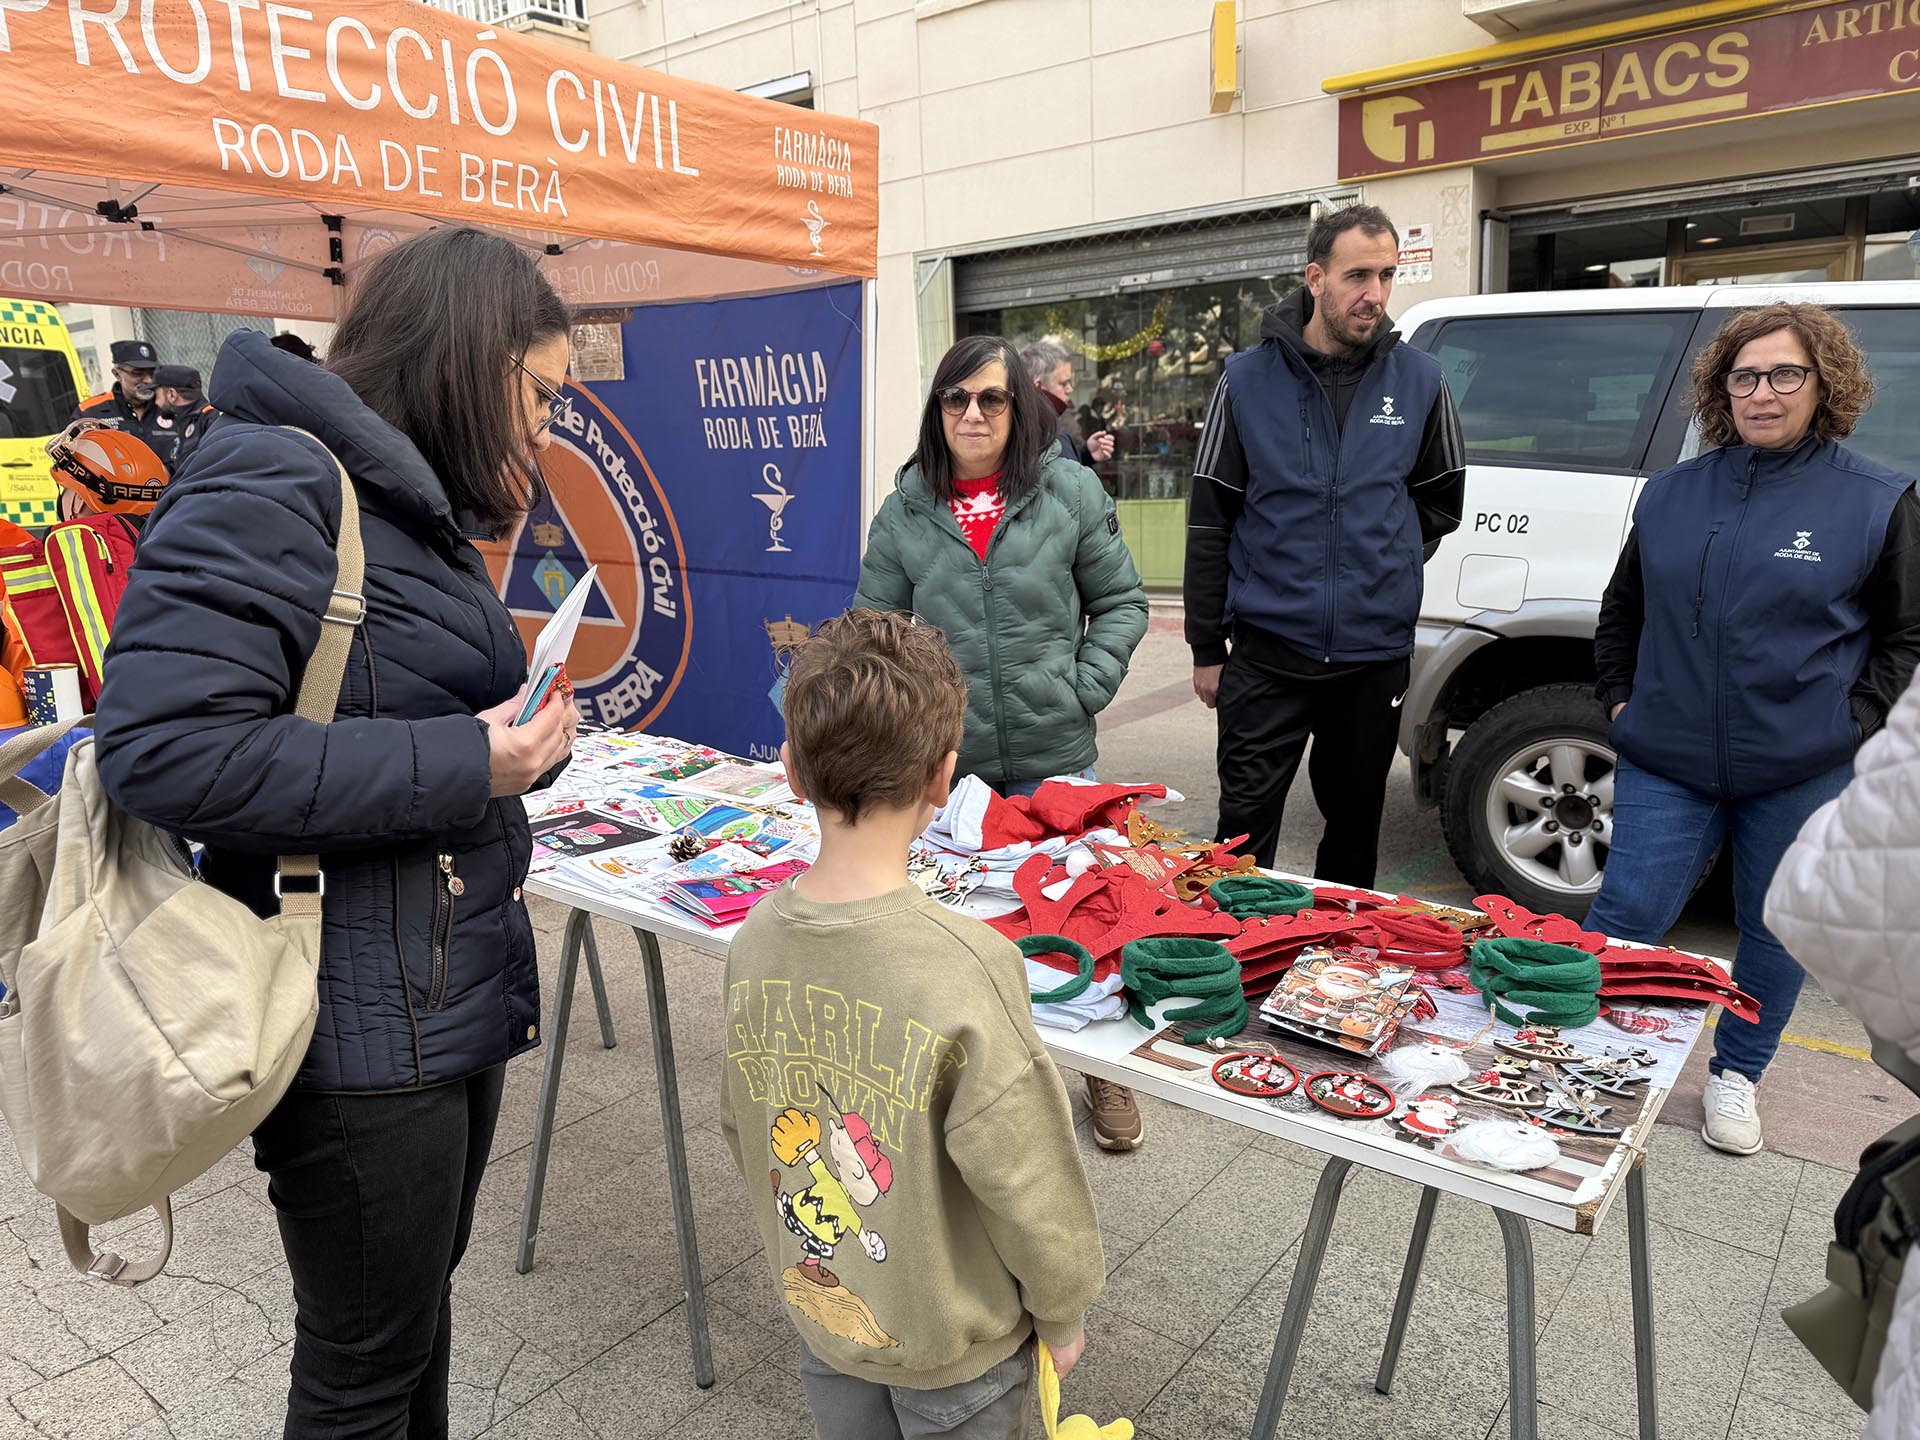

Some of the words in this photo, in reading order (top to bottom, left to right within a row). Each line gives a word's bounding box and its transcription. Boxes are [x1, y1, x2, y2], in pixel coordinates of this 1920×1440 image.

[1478, 31, 1750, 127] TABACS
[1889, 49, 1920, 82] C
[546, 69, 700, 177] CIVIL
[775, 126, 852, 173] FARMÀCIA
[1564, 120, 1593, 135] EXP.
[1620, 114, 1627, 126] 1
[212, 117, 363, 188] RODA
[378, 139, 443, 198] DE
[460, 152, 569, 218] BERÀ
[776, 164, 807, 190] RODA
[810, 170, 824, 193] DE
[827, 173, 853, 199] BERÀ
[695, 344, 828, 408] FARMÀCIA
[703, 416, 754, 450] RODA
[757, 416, 784, 449] DE
[585, 418, 667, 554] Protecció
[650, 556, 677, 620] Civil
[1474, 512, 1502, 534] PC
[1506, 513, 1530, 534] 02
[738, 1056, 904, 1153] BROWN
